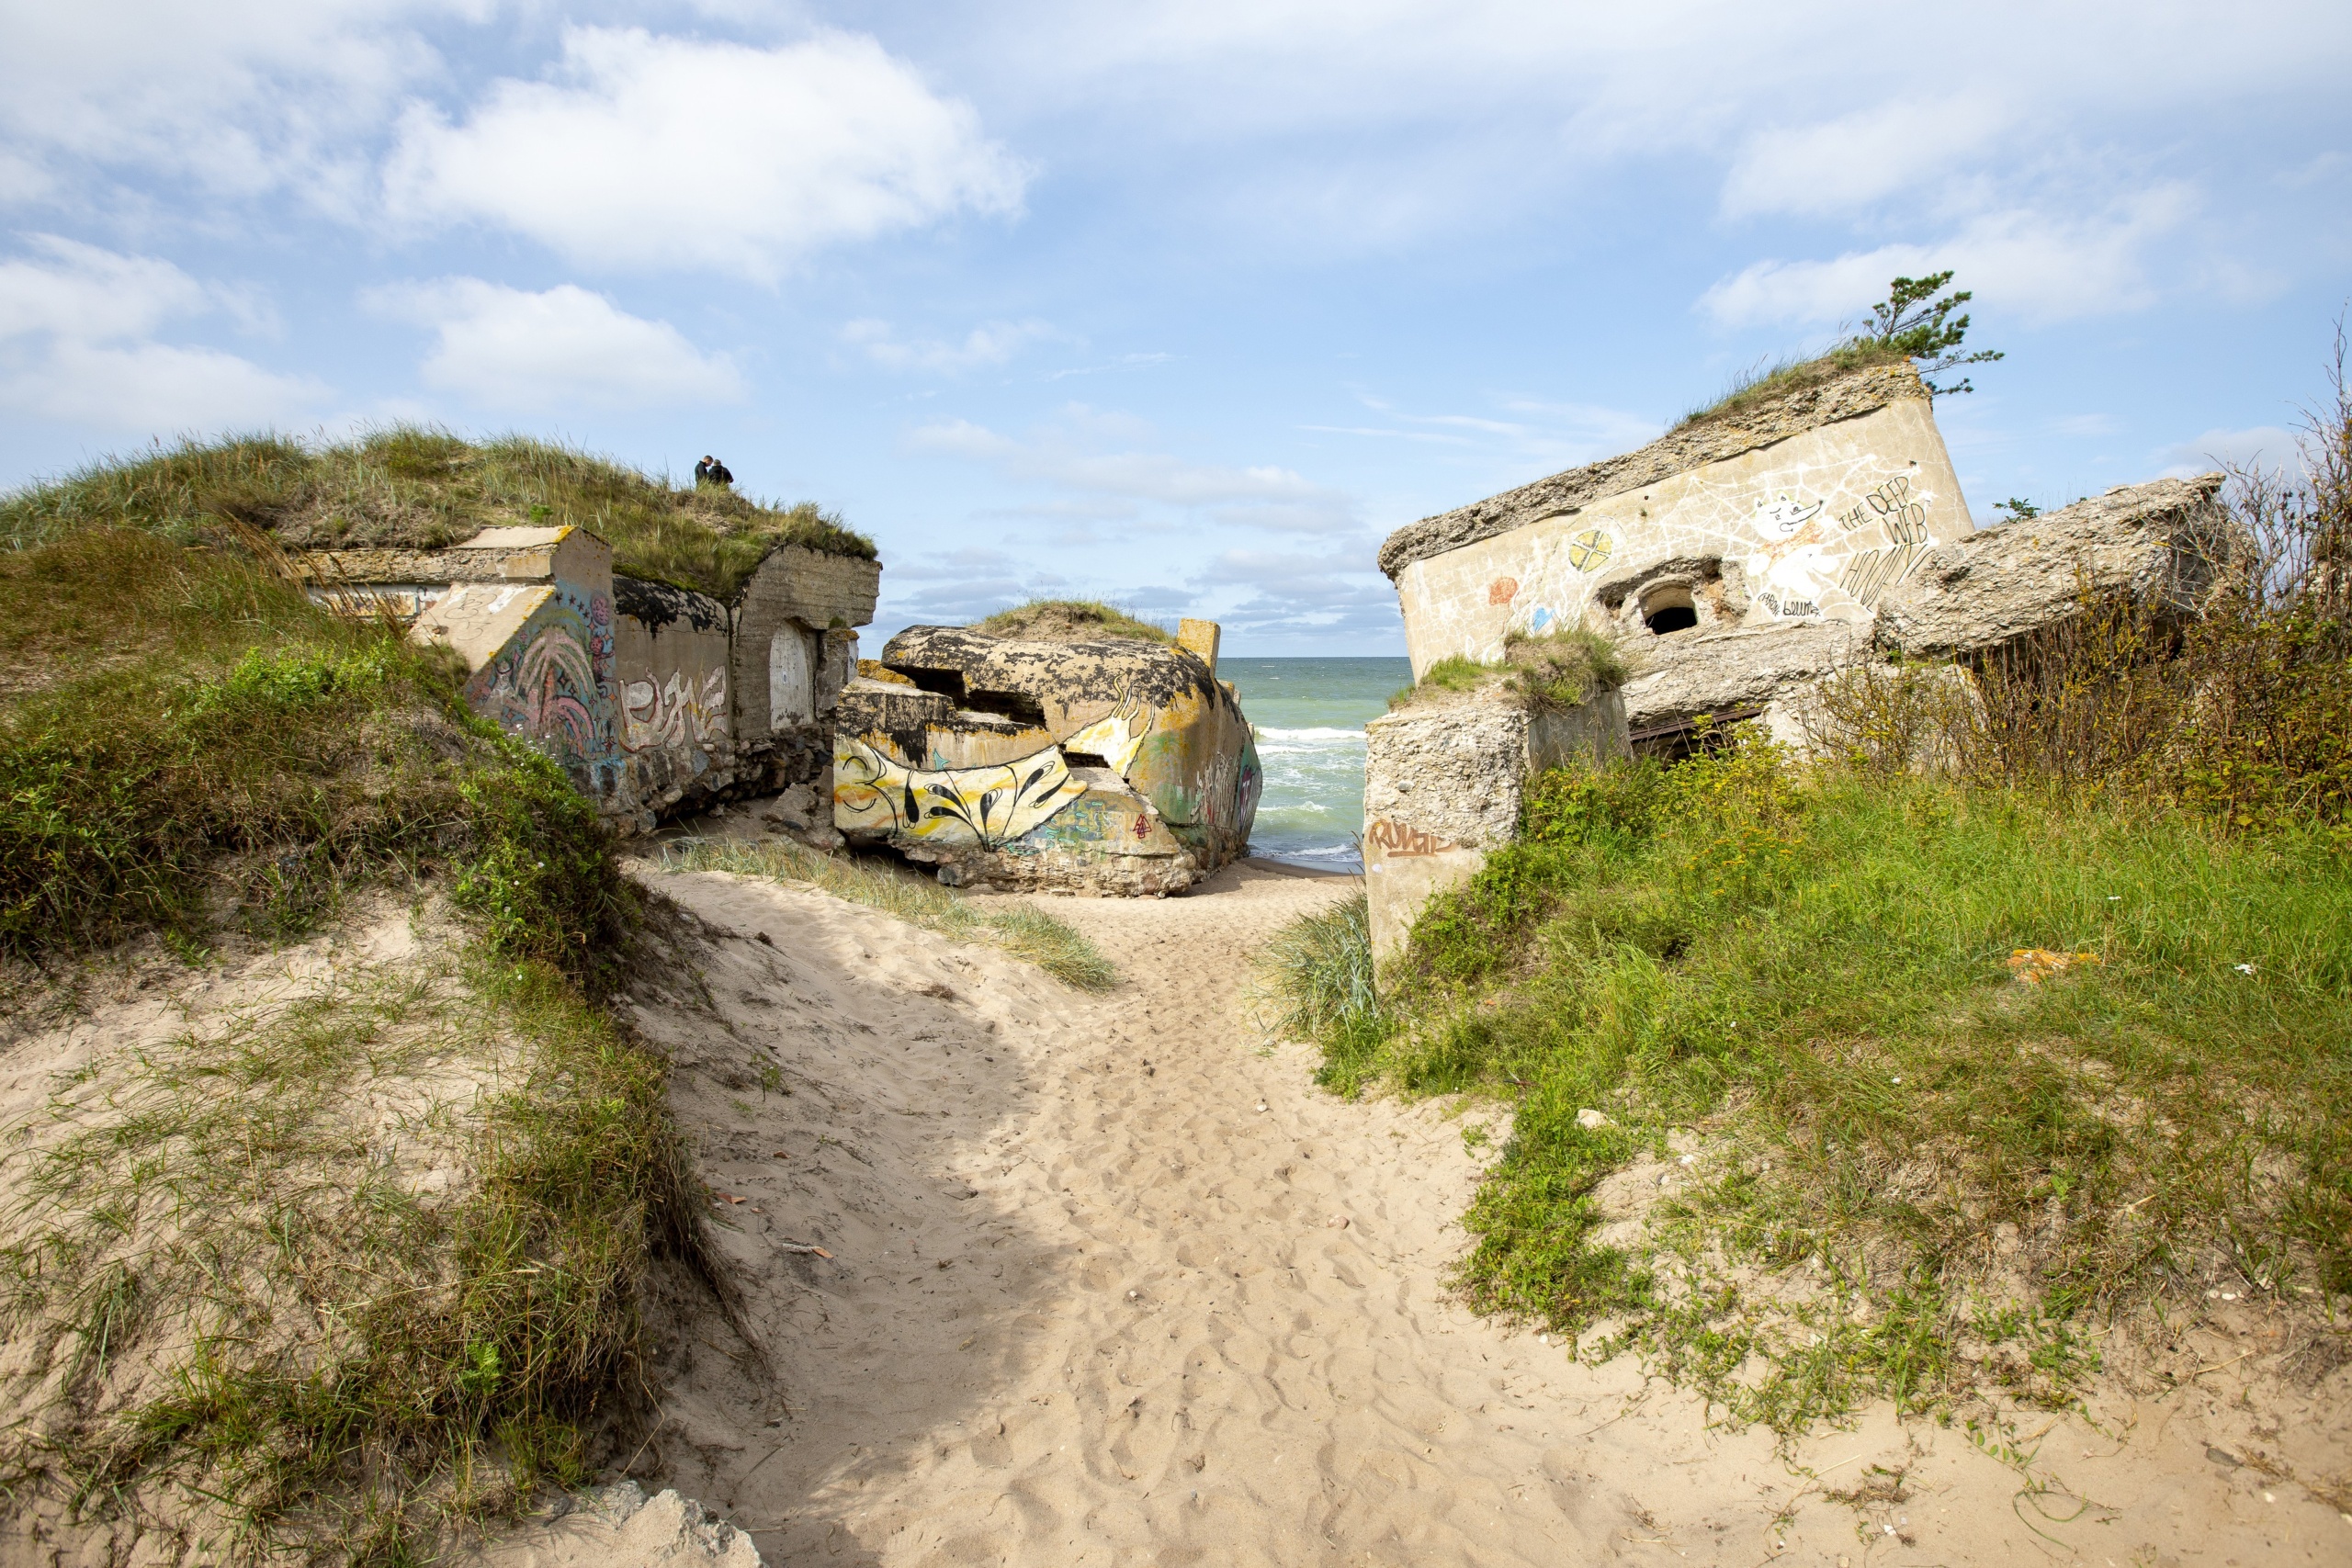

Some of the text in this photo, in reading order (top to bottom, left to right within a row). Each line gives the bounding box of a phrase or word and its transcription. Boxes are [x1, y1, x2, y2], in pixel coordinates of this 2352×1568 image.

[1838, 476, 1909, 532] THE DEEP
[1882, 502, 1928, 545] WEB
